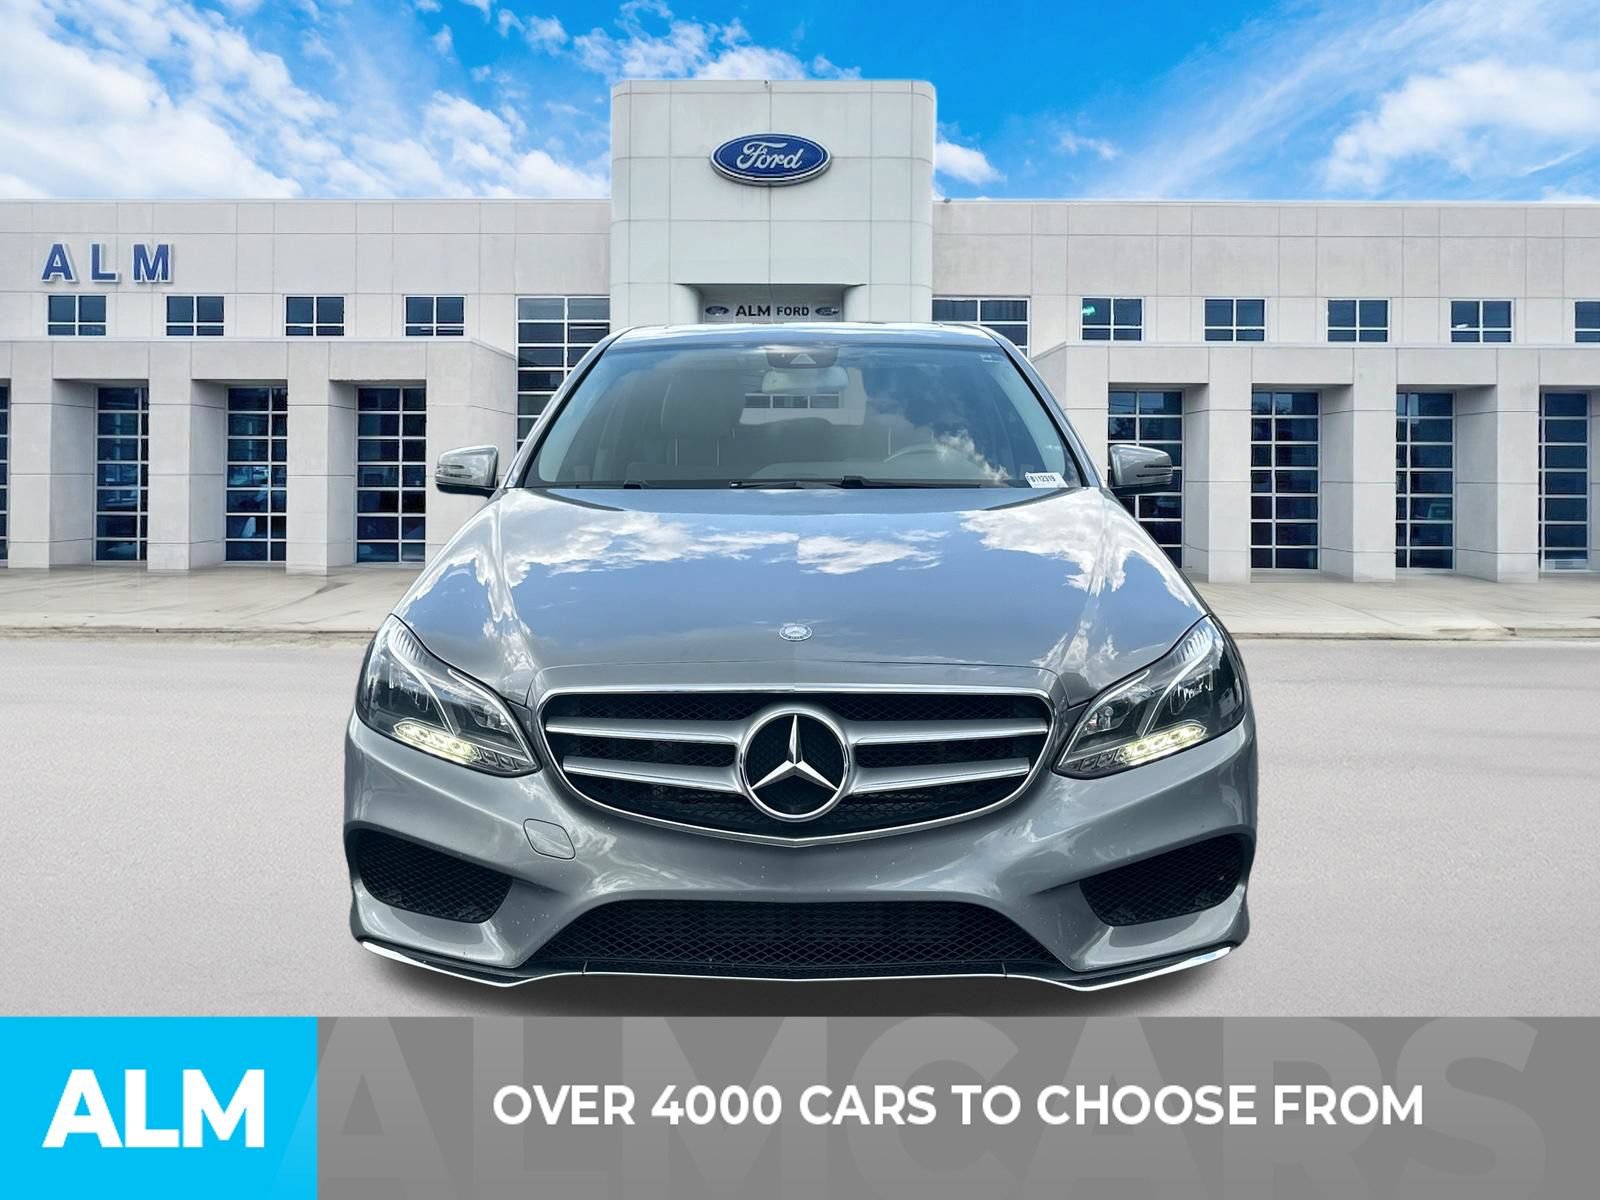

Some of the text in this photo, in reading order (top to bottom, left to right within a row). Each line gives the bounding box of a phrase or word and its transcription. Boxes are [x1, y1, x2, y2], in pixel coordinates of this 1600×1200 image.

[736, 141, 805, 169] Ford
[41, 243, 170, 281] ALM
[735, 304, 771, 317] ALM
[776, 306, 810, 316] FORD
